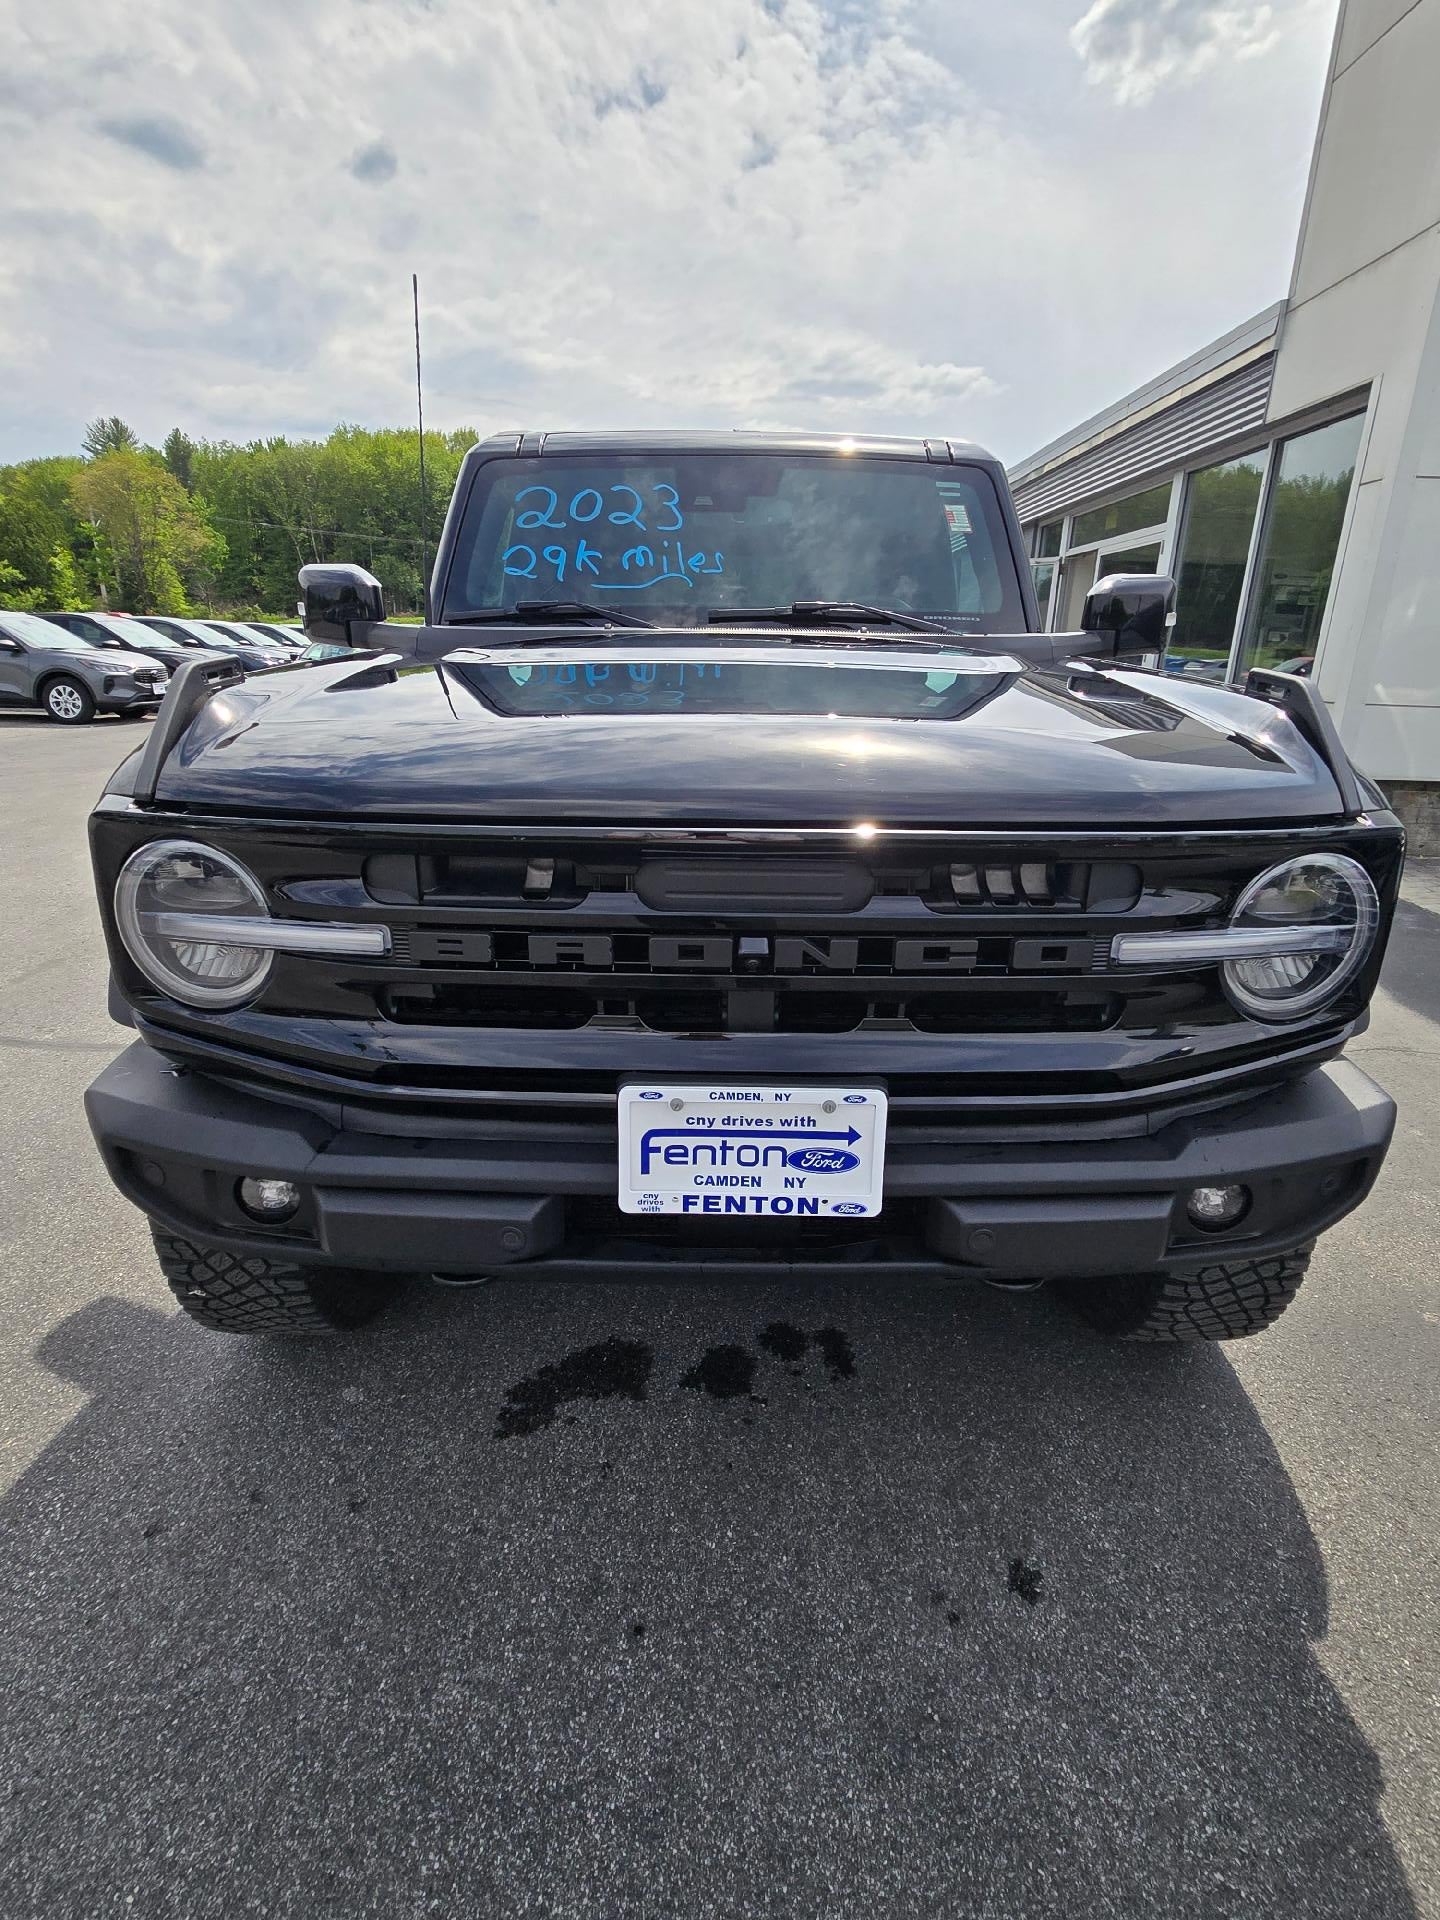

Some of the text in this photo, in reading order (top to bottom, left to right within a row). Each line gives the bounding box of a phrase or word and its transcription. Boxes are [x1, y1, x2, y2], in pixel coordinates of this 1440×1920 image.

[515, 484, 684, 532] 2023
[622, 540, 724, 575] miles
[407, 931, 1096, 970] BRONCO
[709, 1091, 792, 1102] CAMDEN, NY
[685, 1116, 817, 1128] cny drives with
[693, 1174, 807, 1189] CAMDEN NY
[682, 1194, 819, 1215] FENTON
